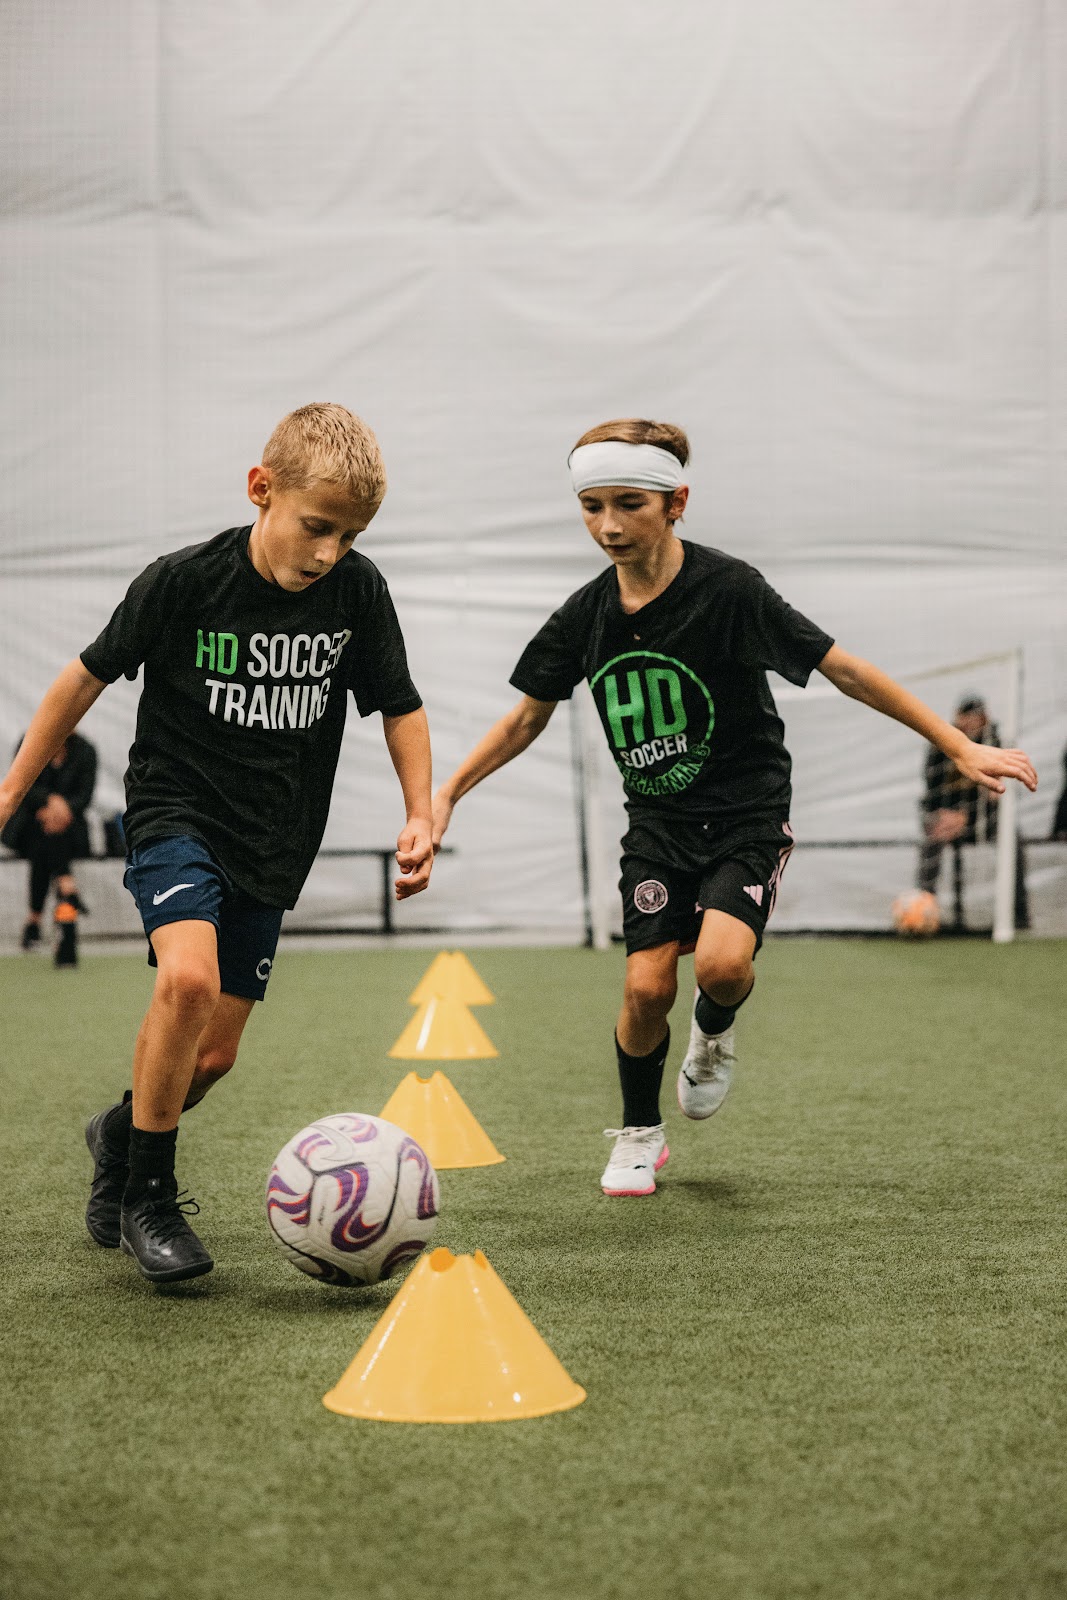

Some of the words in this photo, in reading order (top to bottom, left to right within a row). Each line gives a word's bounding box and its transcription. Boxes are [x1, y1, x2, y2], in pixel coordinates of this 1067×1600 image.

[196, 629, 238, 675] HD
[205, 678, 330, 729] TRAINING
[604, 668, 687, 748] HD
[620, 733, 687, 769] SOCCER
